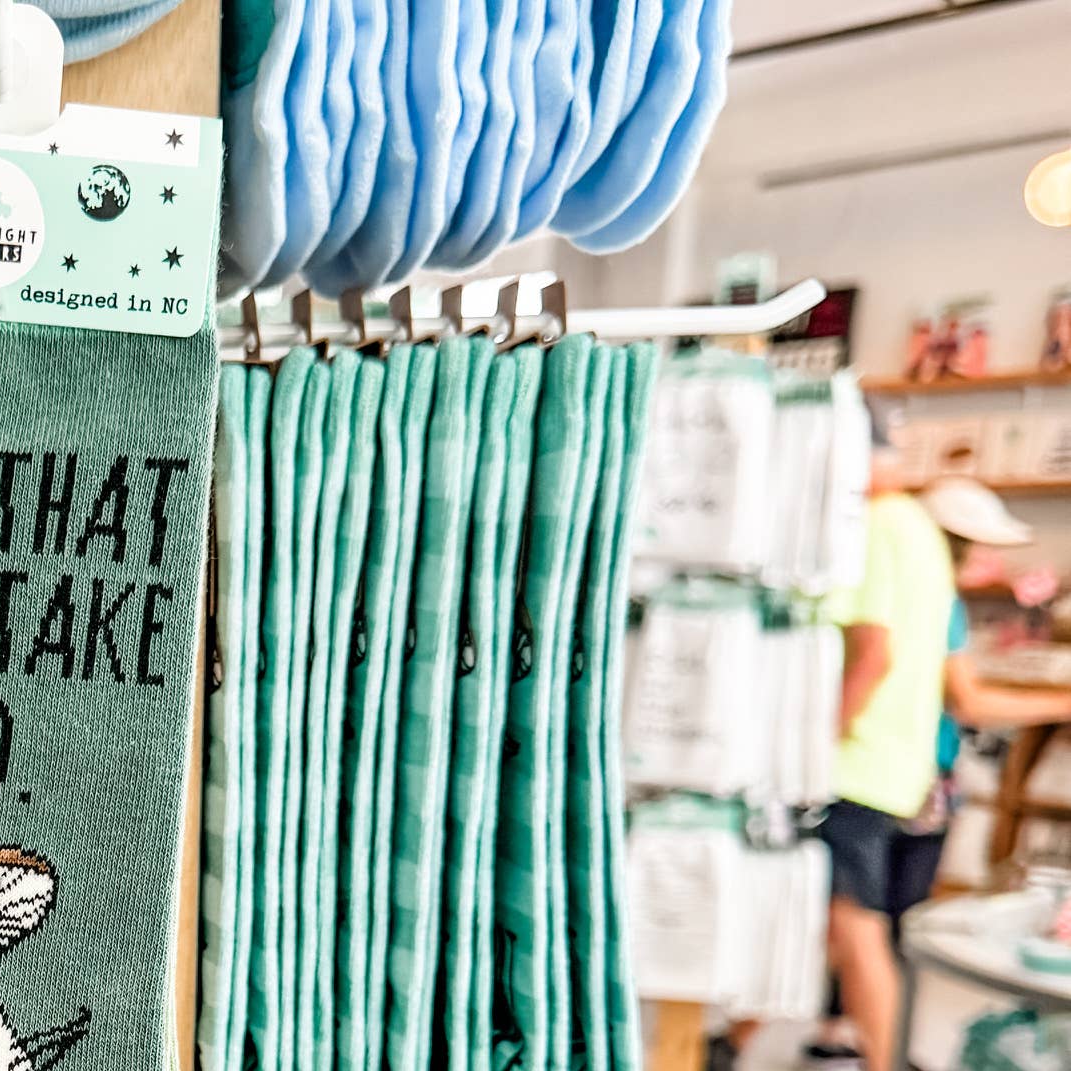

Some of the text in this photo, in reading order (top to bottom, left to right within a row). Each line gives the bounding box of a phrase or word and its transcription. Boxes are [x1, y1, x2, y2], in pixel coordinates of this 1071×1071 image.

[19, 285, 189, 316] designed in NC
